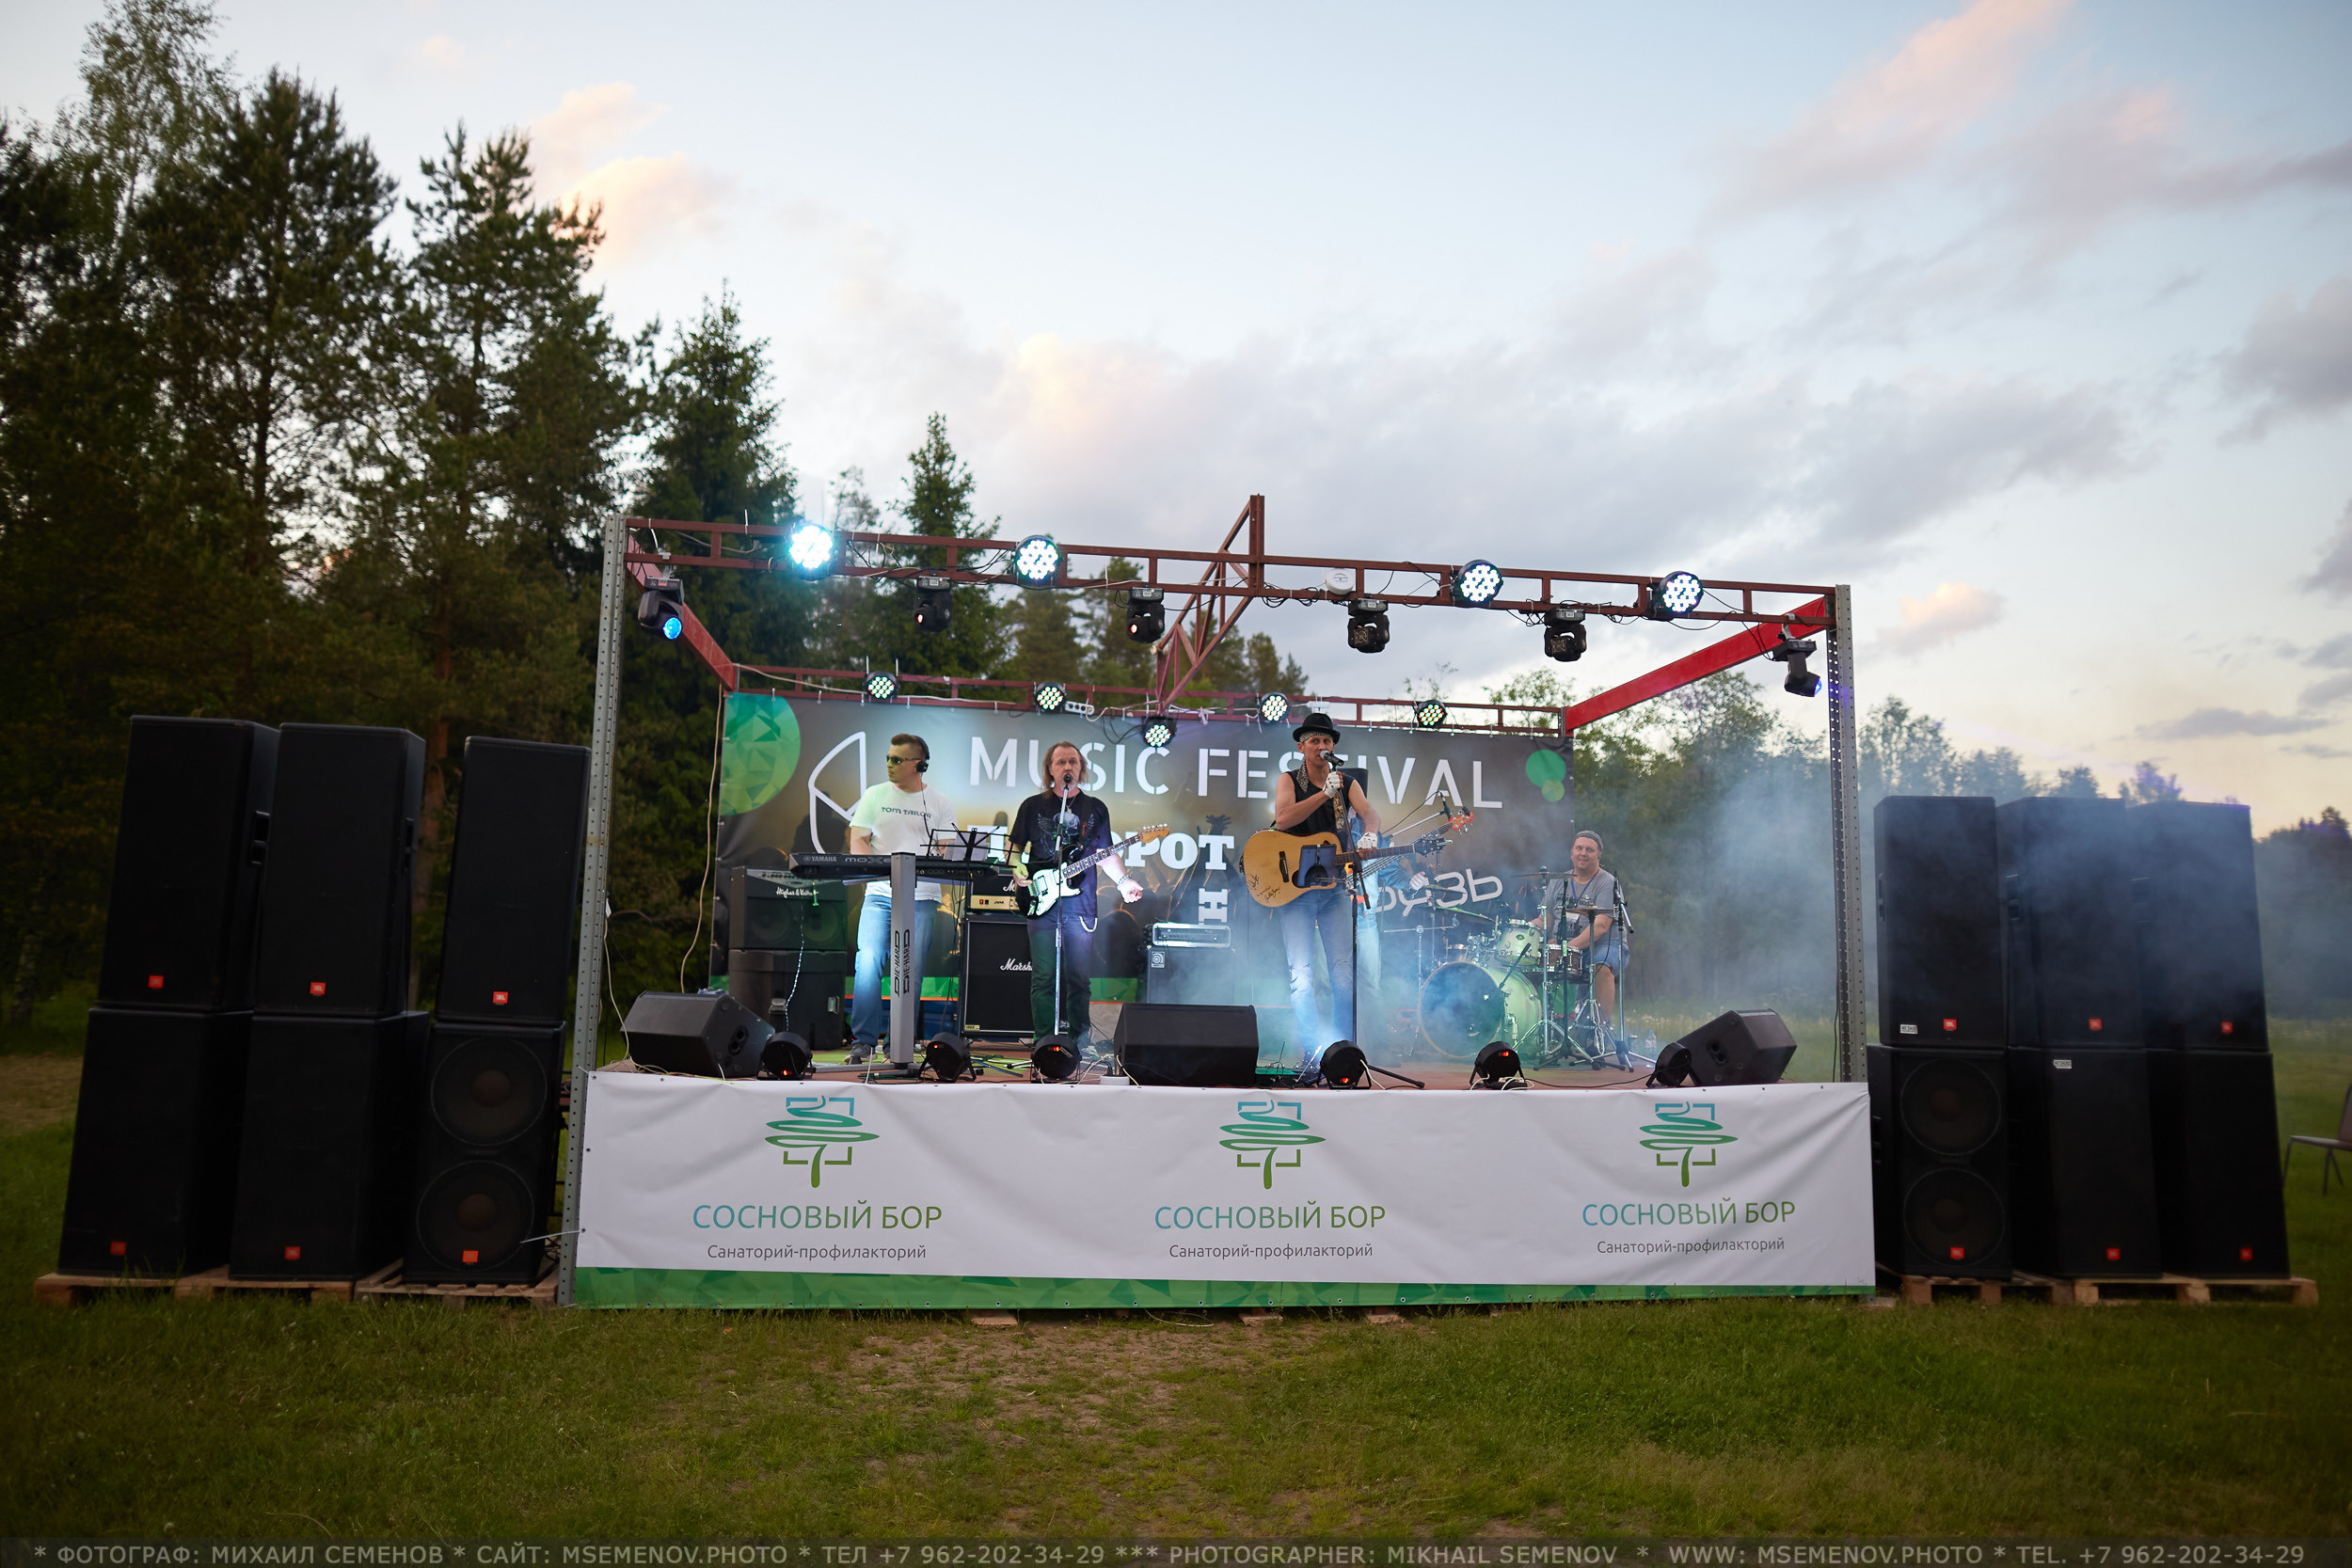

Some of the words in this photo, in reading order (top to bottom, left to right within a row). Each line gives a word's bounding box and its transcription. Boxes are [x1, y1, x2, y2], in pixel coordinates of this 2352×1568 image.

[970, 736, 1170, 795] MUSIC
[1000, 958, 1032, 972] Marsh
[692, 1199, 873, 1230] СОСНОВЫЙ
[882, 1206, 943, 1230] БОР
[1155, 1200, 1322, 1230] СОСНОВЫЙ
[1331, 1205, 1386, 1229] БОР
[1582, 1197, 1738, 1227] СОСНОВЫЙ
[1745, 1201, 1796, 1225] БОР
[707, 1243, 927, 1261] Санаторий-профилакторий
[1169, 1243, 1374, 1261] Санаторий-профилакторий
[1597, 1237, 1786, 1256] Санаторий-профилакторий
